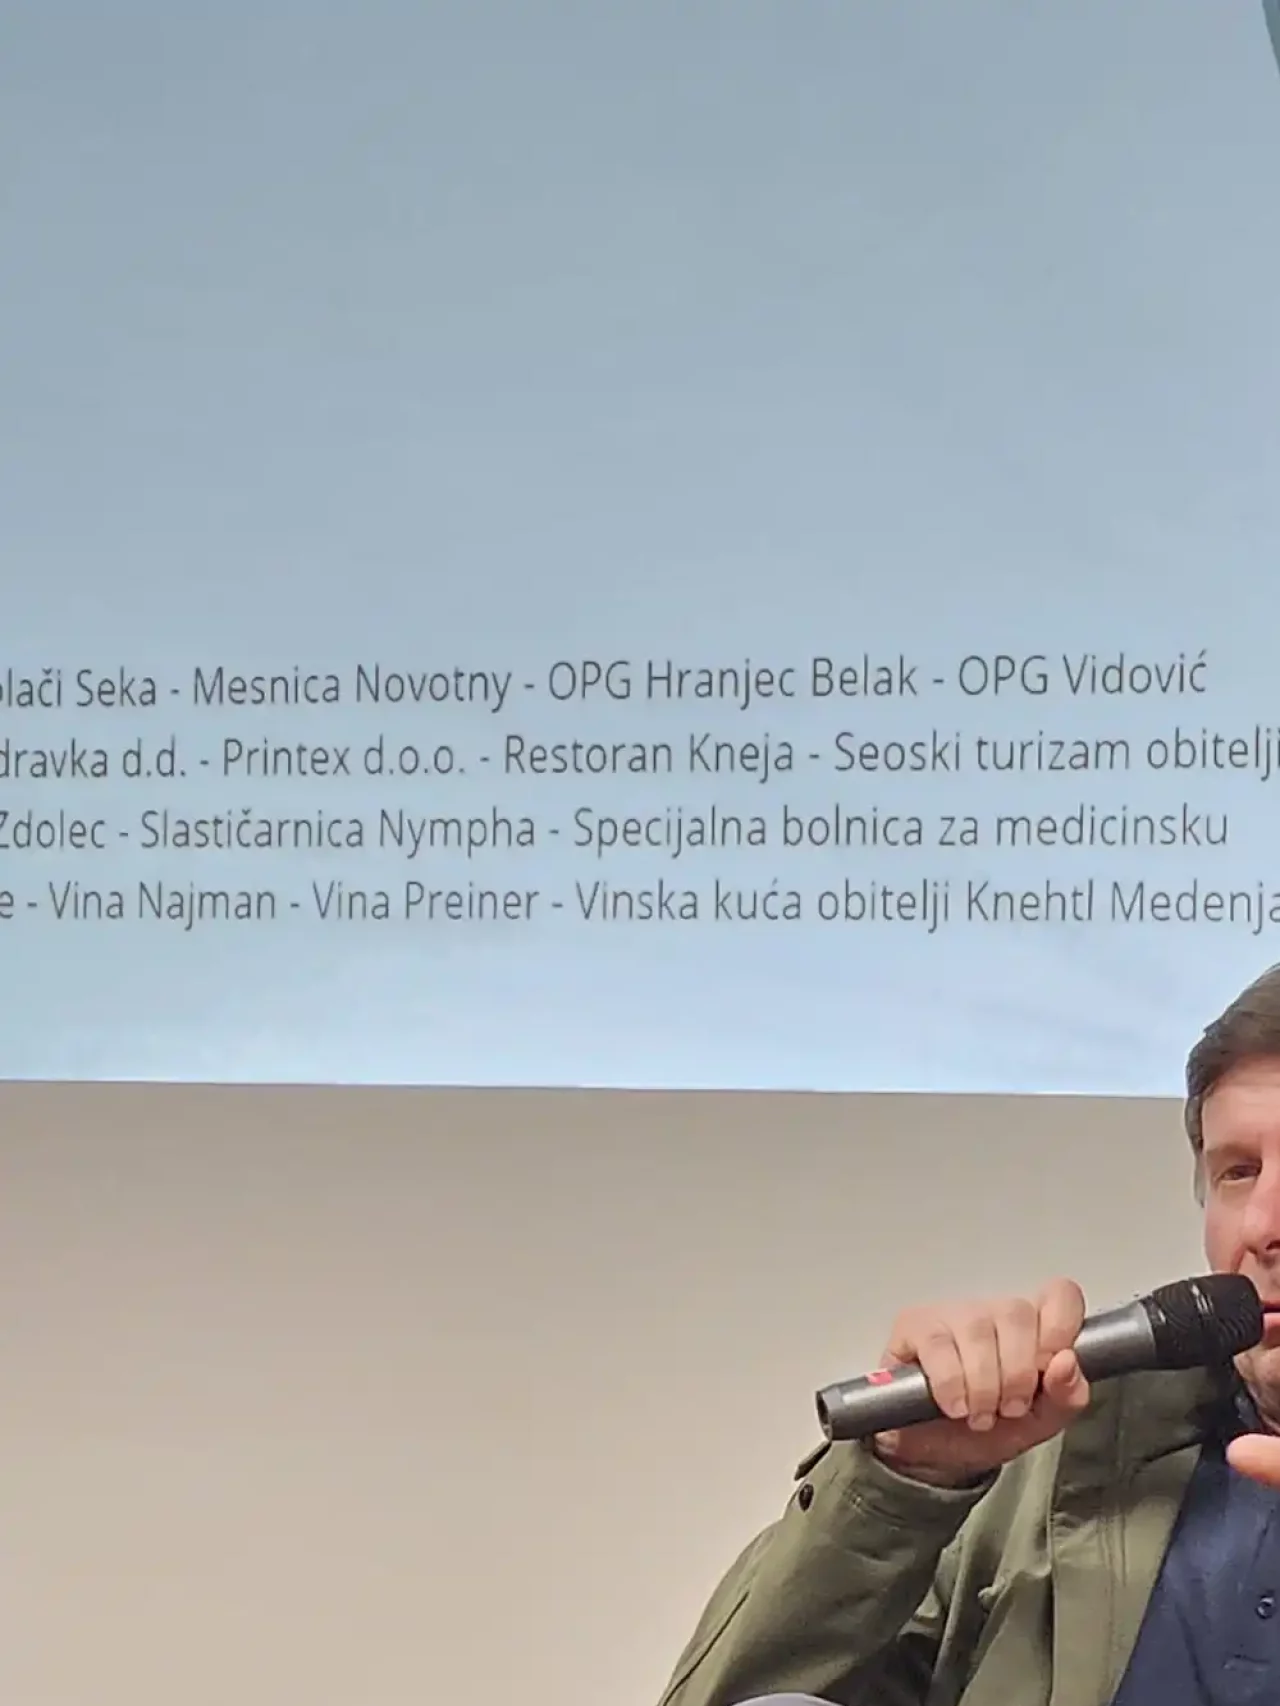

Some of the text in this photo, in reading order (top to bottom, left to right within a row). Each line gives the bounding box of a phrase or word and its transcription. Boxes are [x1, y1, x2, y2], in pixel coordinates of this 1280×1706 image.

[0, 668, 62, 708] lači
[76, 666, 156, 708] Seka
[194, 666, 340, 706] Mesnica
[356, 663, 512, 714] Novotny
[549, 660, 631, 700] OPG
[647, 658, 795, 711] Hranjec
[812, 653, 917, 697] Belak
[958, 655, 1048, 696] OPG
[1062, 649, 1206, 695] Vidović
[122, 735, 186, 778] d.d.
[224, 737, 350, 776] Printex
[364, 734, 465, 775] d.o.o.
[505, 734, 672, 774] Restoran
[690, 733, 793, 784] Kneja
[835, 729, 960, 772] Seoski
[976, 730, 1129, 771] turizam
[141, 808, 363, 849] Slastičarnica
[380, 806, 534, 859] Nympha
[574, 804, 766, 859] Specijalna
[783, 803, 922, 846] bolnica
[938, 816, 978, 846] za
[997, 802, 1227, 846] medicinsku
[49, 880, 124, 920] Vina
[139, 881, 275, 931] Najman
[313, 880, 389, 920] Vina
[406, 881, 540, 920] Preiner
[576, 878, 698, 920] Vinska
[715, 878, 800, 921] kuća
[818, 878, 949, 934] obitelji
[968, 878, 1093, 922] Knehtl
